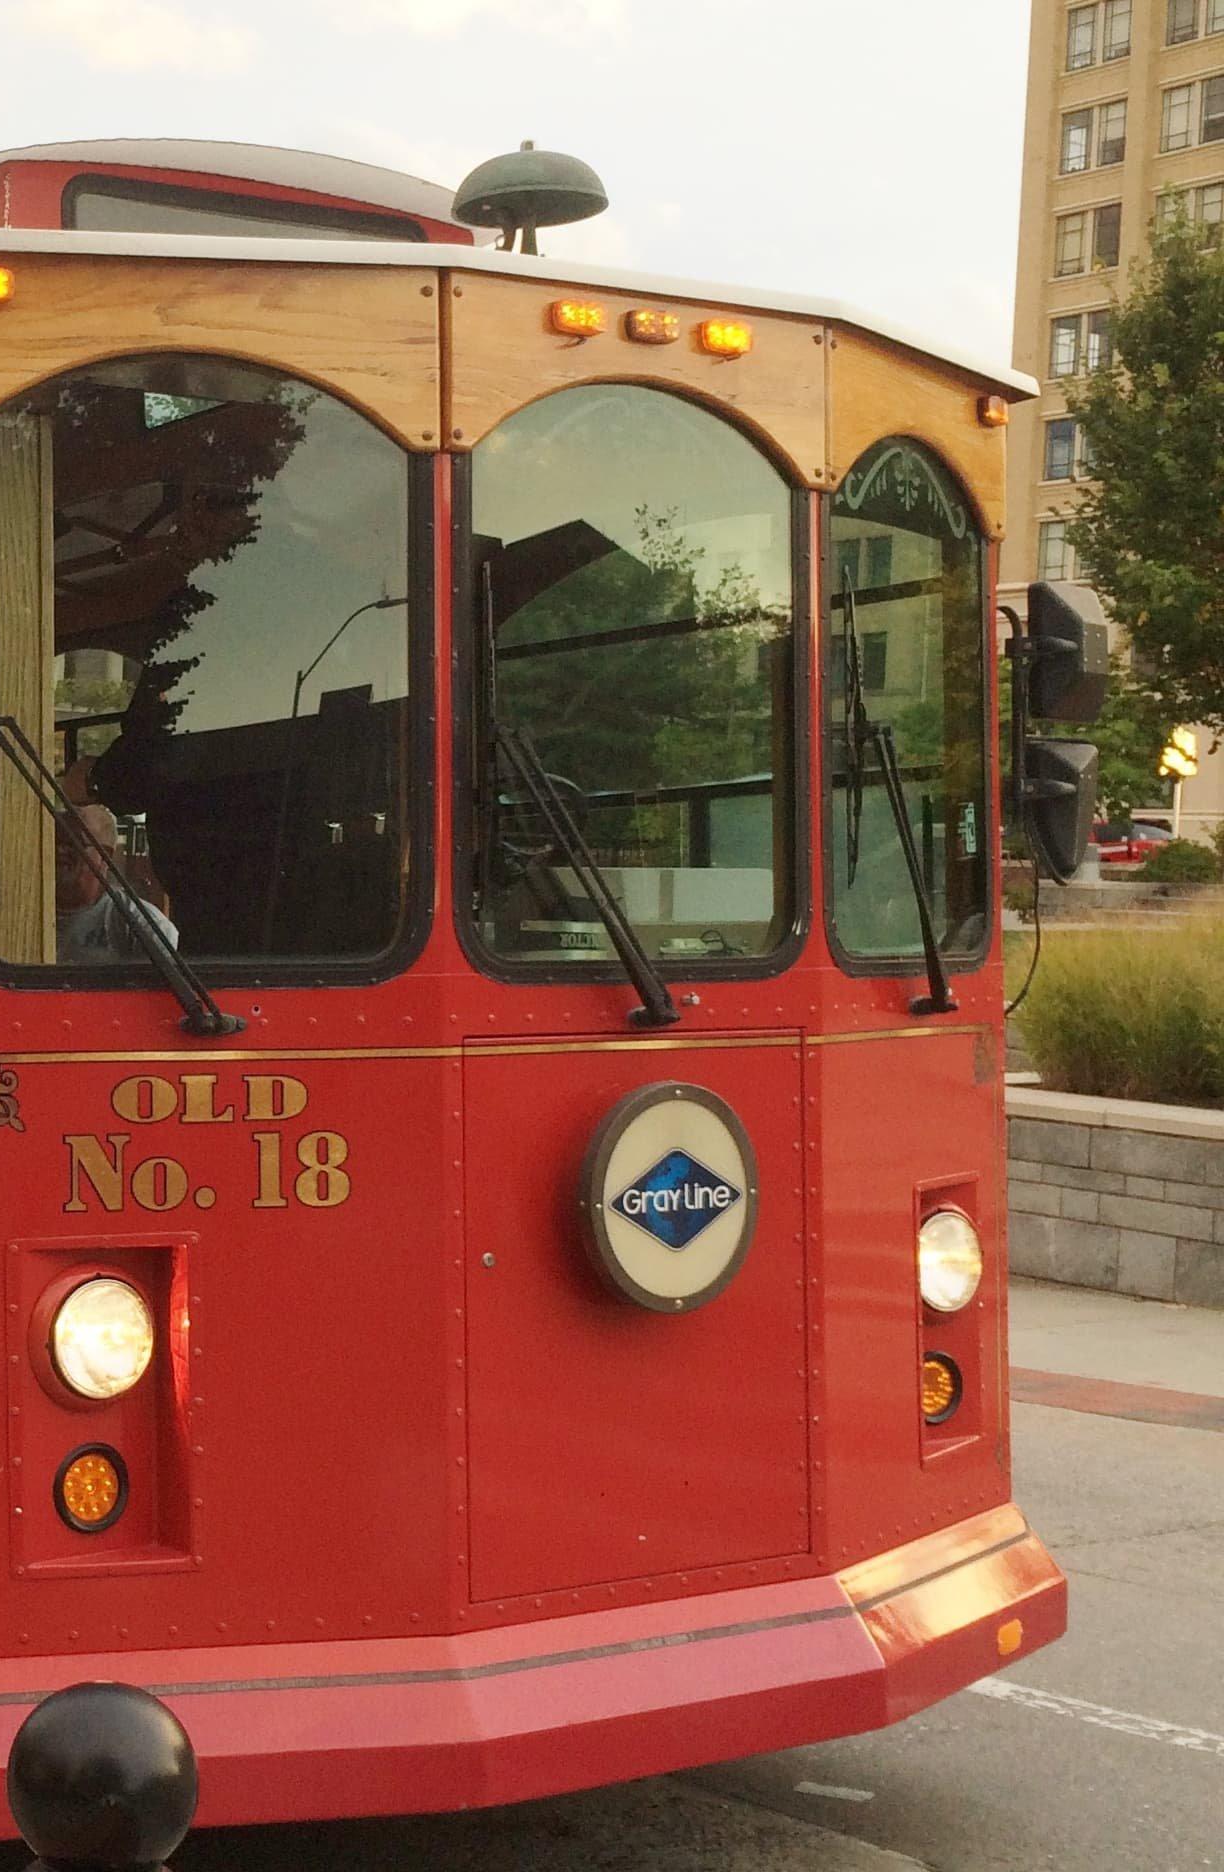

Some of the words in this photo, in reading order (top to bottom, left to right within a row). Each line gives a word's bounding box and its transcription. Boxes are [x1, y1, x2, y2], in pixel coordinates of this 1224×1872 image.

[110, 1074, 308, 1124] OLD
[63, 1134, 217, 1212] No.
[252, 1130, 351, 1208] 18
